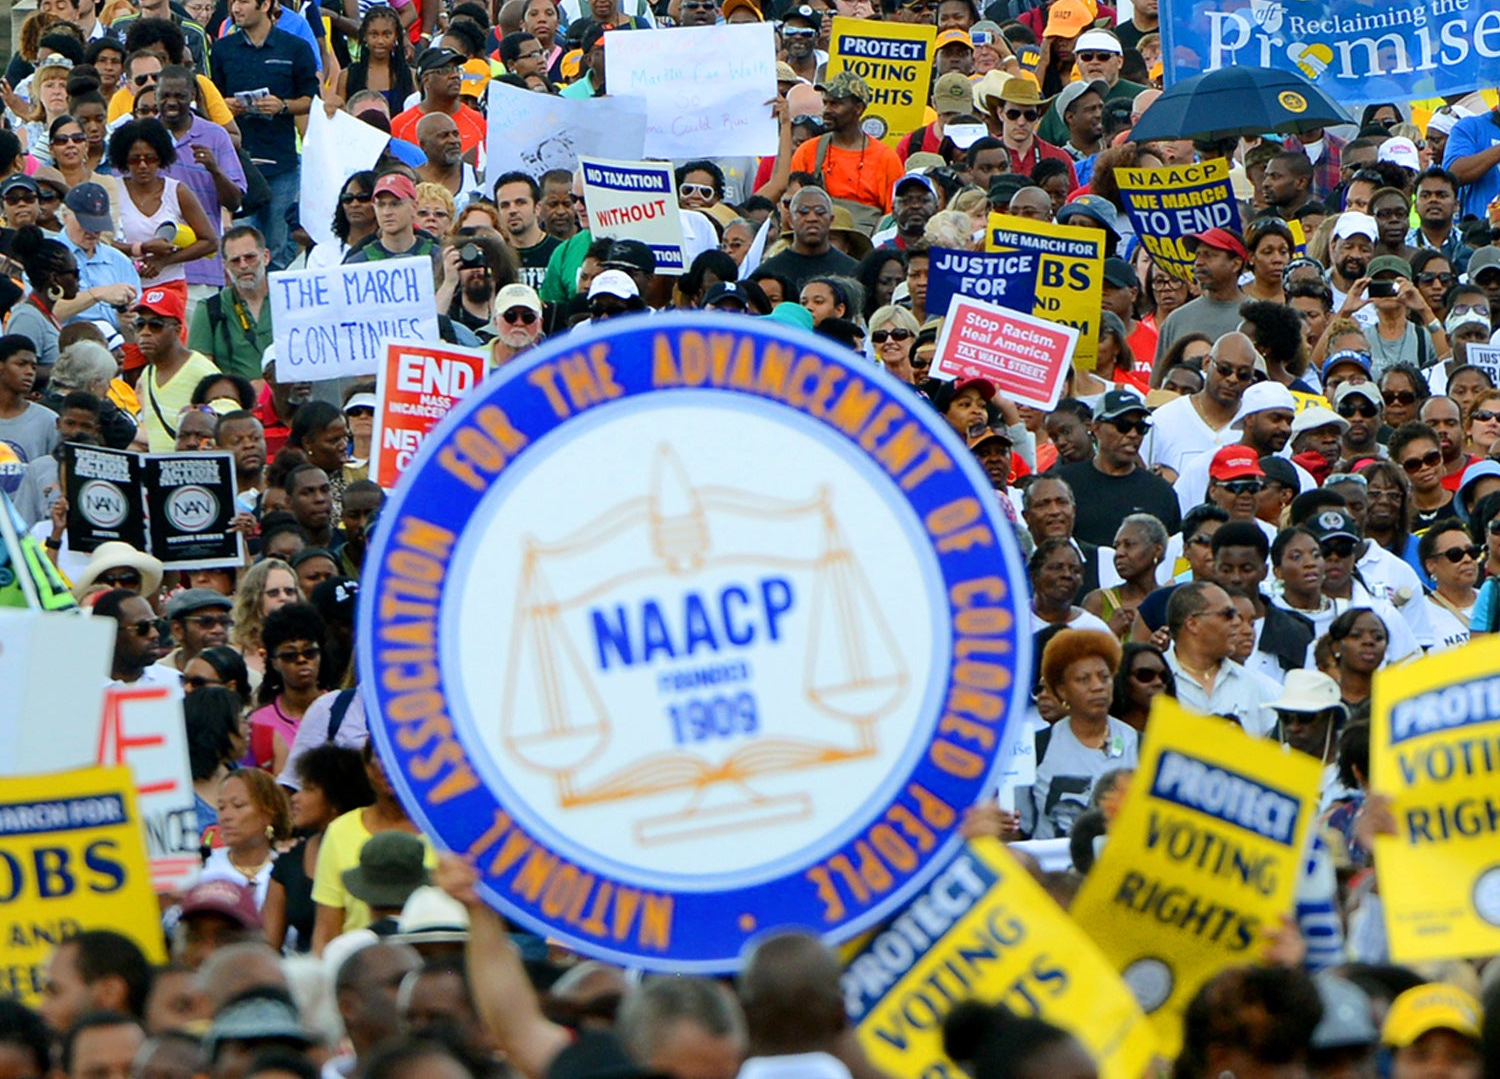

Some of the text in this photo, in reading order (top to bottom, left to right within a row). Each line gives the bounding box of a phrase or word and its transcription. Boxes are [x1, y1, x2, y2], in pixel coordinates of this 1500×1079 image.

[1290, 6, 1428, 36] Reclaiming
[843, 36, 923, 59] PROTECT
[841, 57, 917, 81] VOTING
[586, 166, 664, 189] NO TAXATION
[1128, 164, 1219, 185] NAACP
[1129, 186, 1227, 210] WE MARCH
[595, 199, 667, 228] WITHOUT
[1135, 202, 1234, 235] TO END
[998, 230, 1095, 256] WE MARCH FOR
[935, 252, 1034, 273] JUSTICE
[277, 268, 420, 310] THE MARCH
[959, 276, 1007, 295] FOR
[961, 326, 1053, 362] Heal America.
[965, 312, 1056, 349] Stop Racism.
[397, 354, 474, 396] END
[589, 574, 798, 675] NAACP
[1155, 750, 1300, 840] PROTECT
[1145, 810, 1283, 897] VOTING
[1112, 871, 1257, 952] RIGHTS
